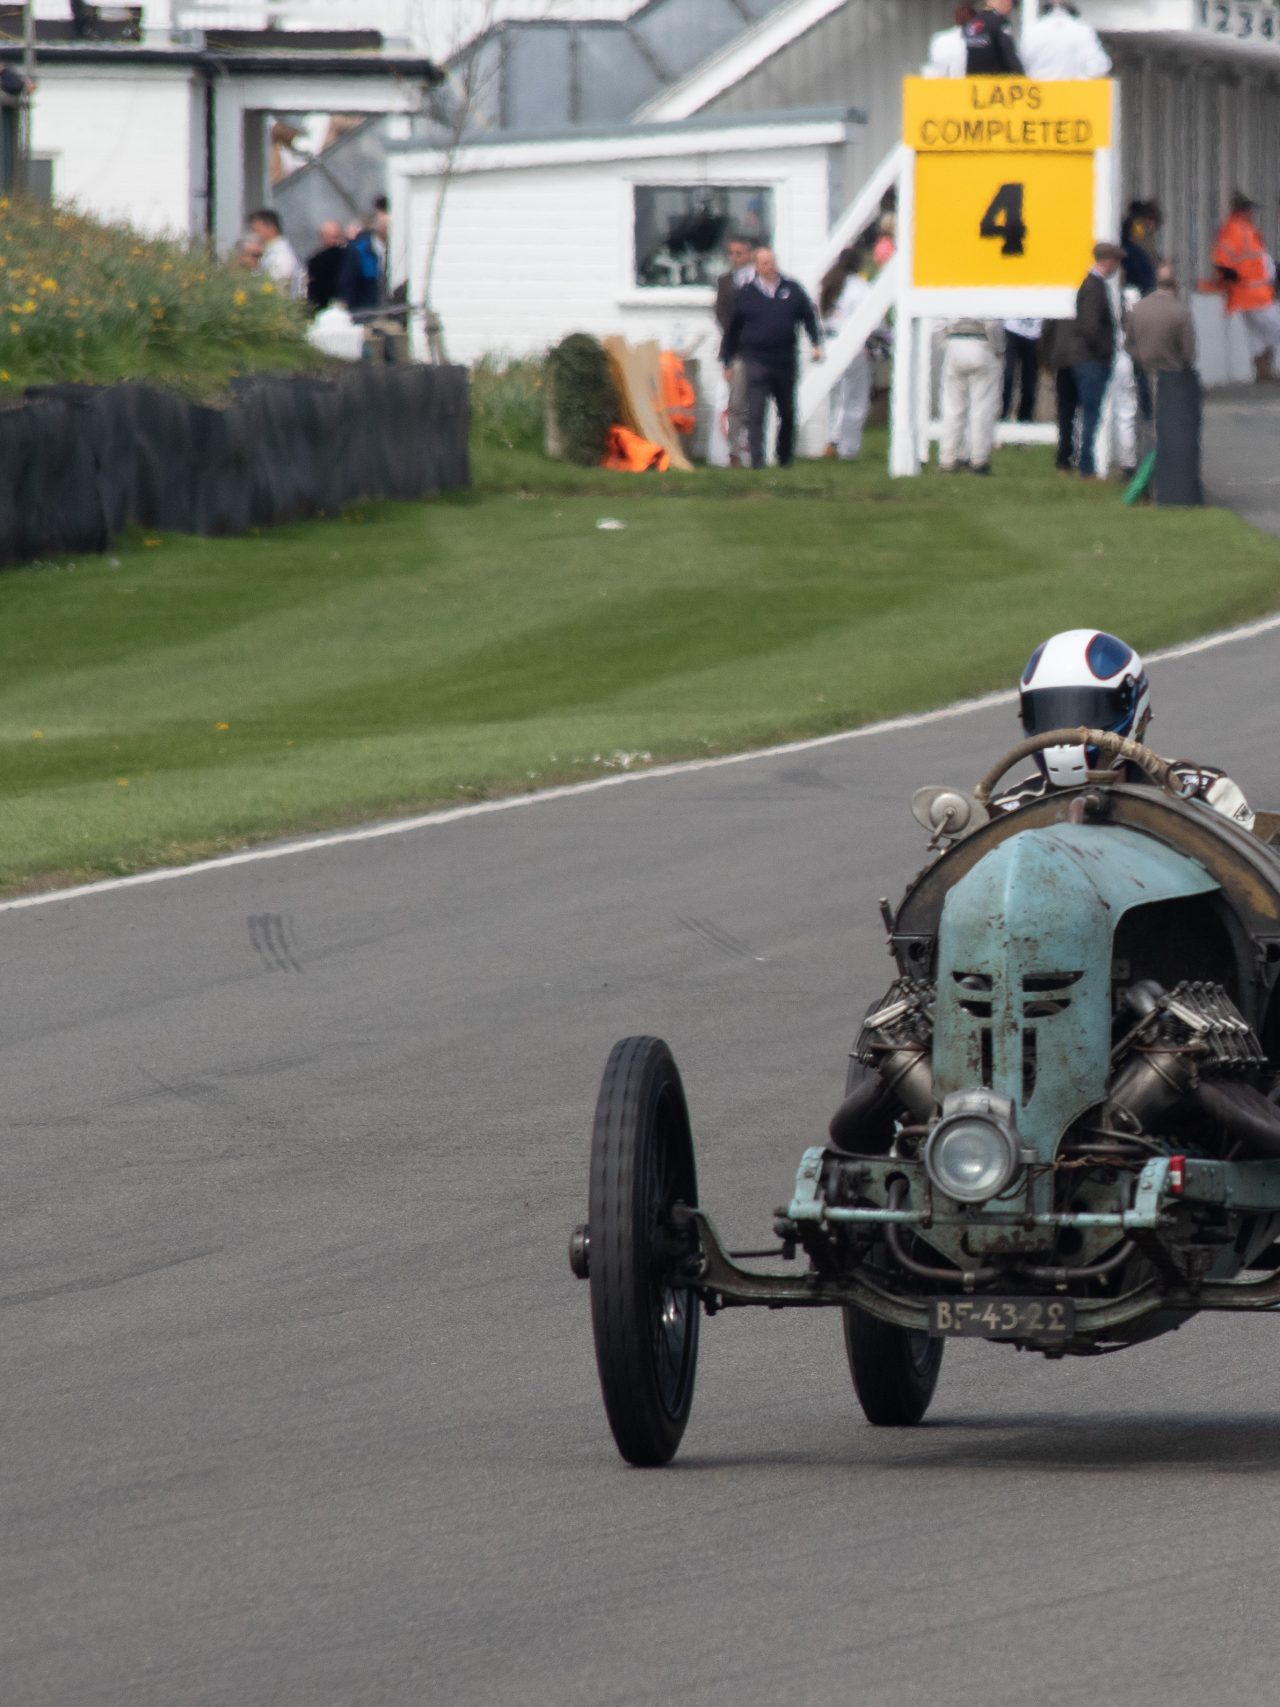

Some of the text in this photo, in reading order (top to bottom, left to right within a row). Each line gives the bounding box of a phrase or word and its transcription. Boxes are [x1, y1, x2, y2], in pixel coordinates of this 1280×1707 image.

[972, 85, 1042, 109] LAPS
[920, 120, 1092, 145] COMPLETED
[980, 183, 1027, 256] 4
